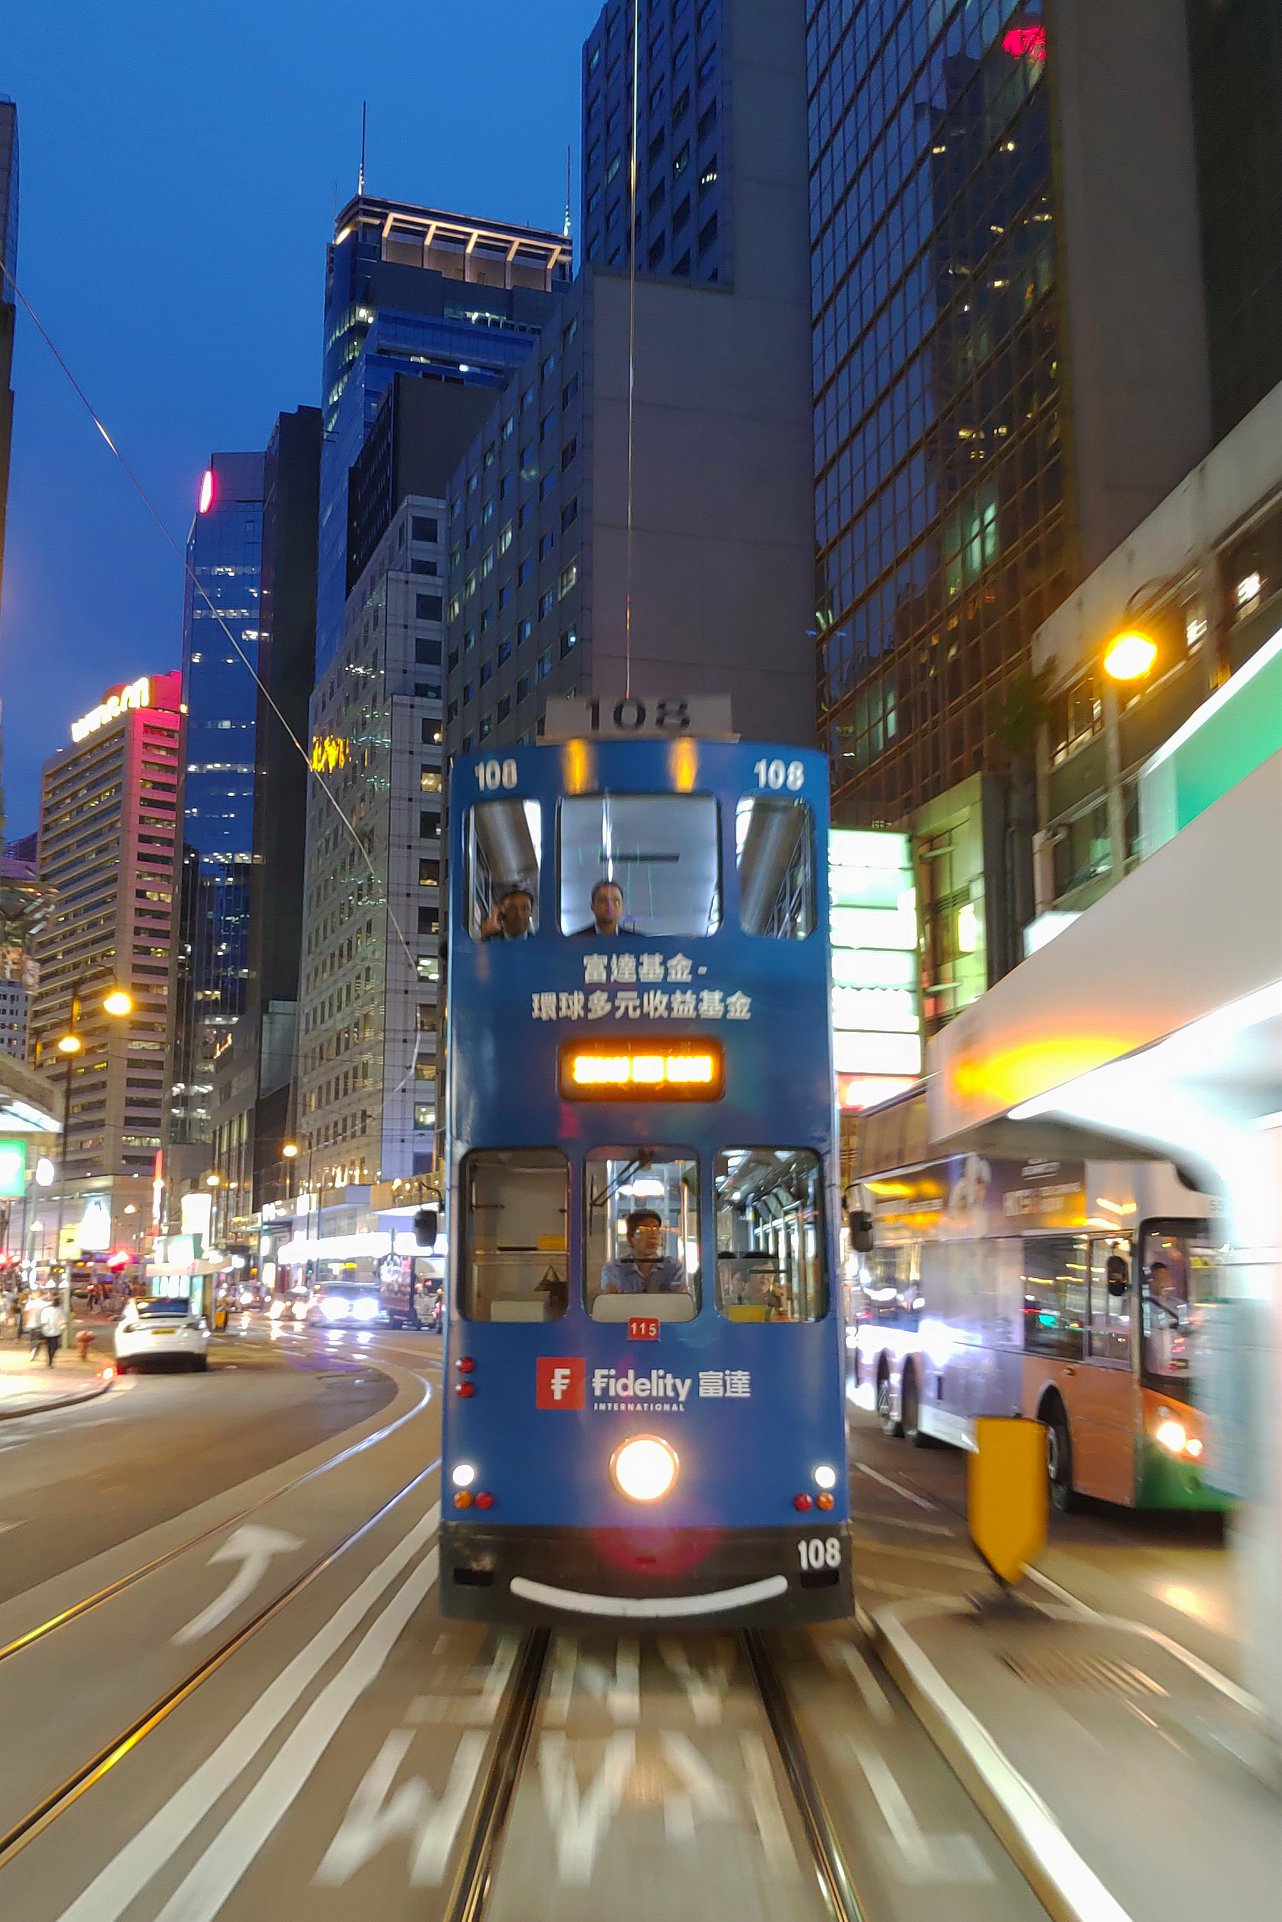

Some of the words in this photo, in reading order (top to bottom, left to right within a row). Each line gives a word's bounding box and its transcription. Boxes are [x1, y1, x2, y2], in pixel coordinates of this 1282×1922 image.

[585, 699, 691, 731] 108
[753, 758, 804, 791] 108
[531, 989, 752, 1021] 環球多元收益基金
[630, 1321, 658, 1337] 115
[592, 1368, 692, 1401] Fidelity
[698, 1370, 751, 1398] 富達
[593, 1402, 686, 1412] INTERNATIONAL
[797, 1537, 842, 1570] 108
